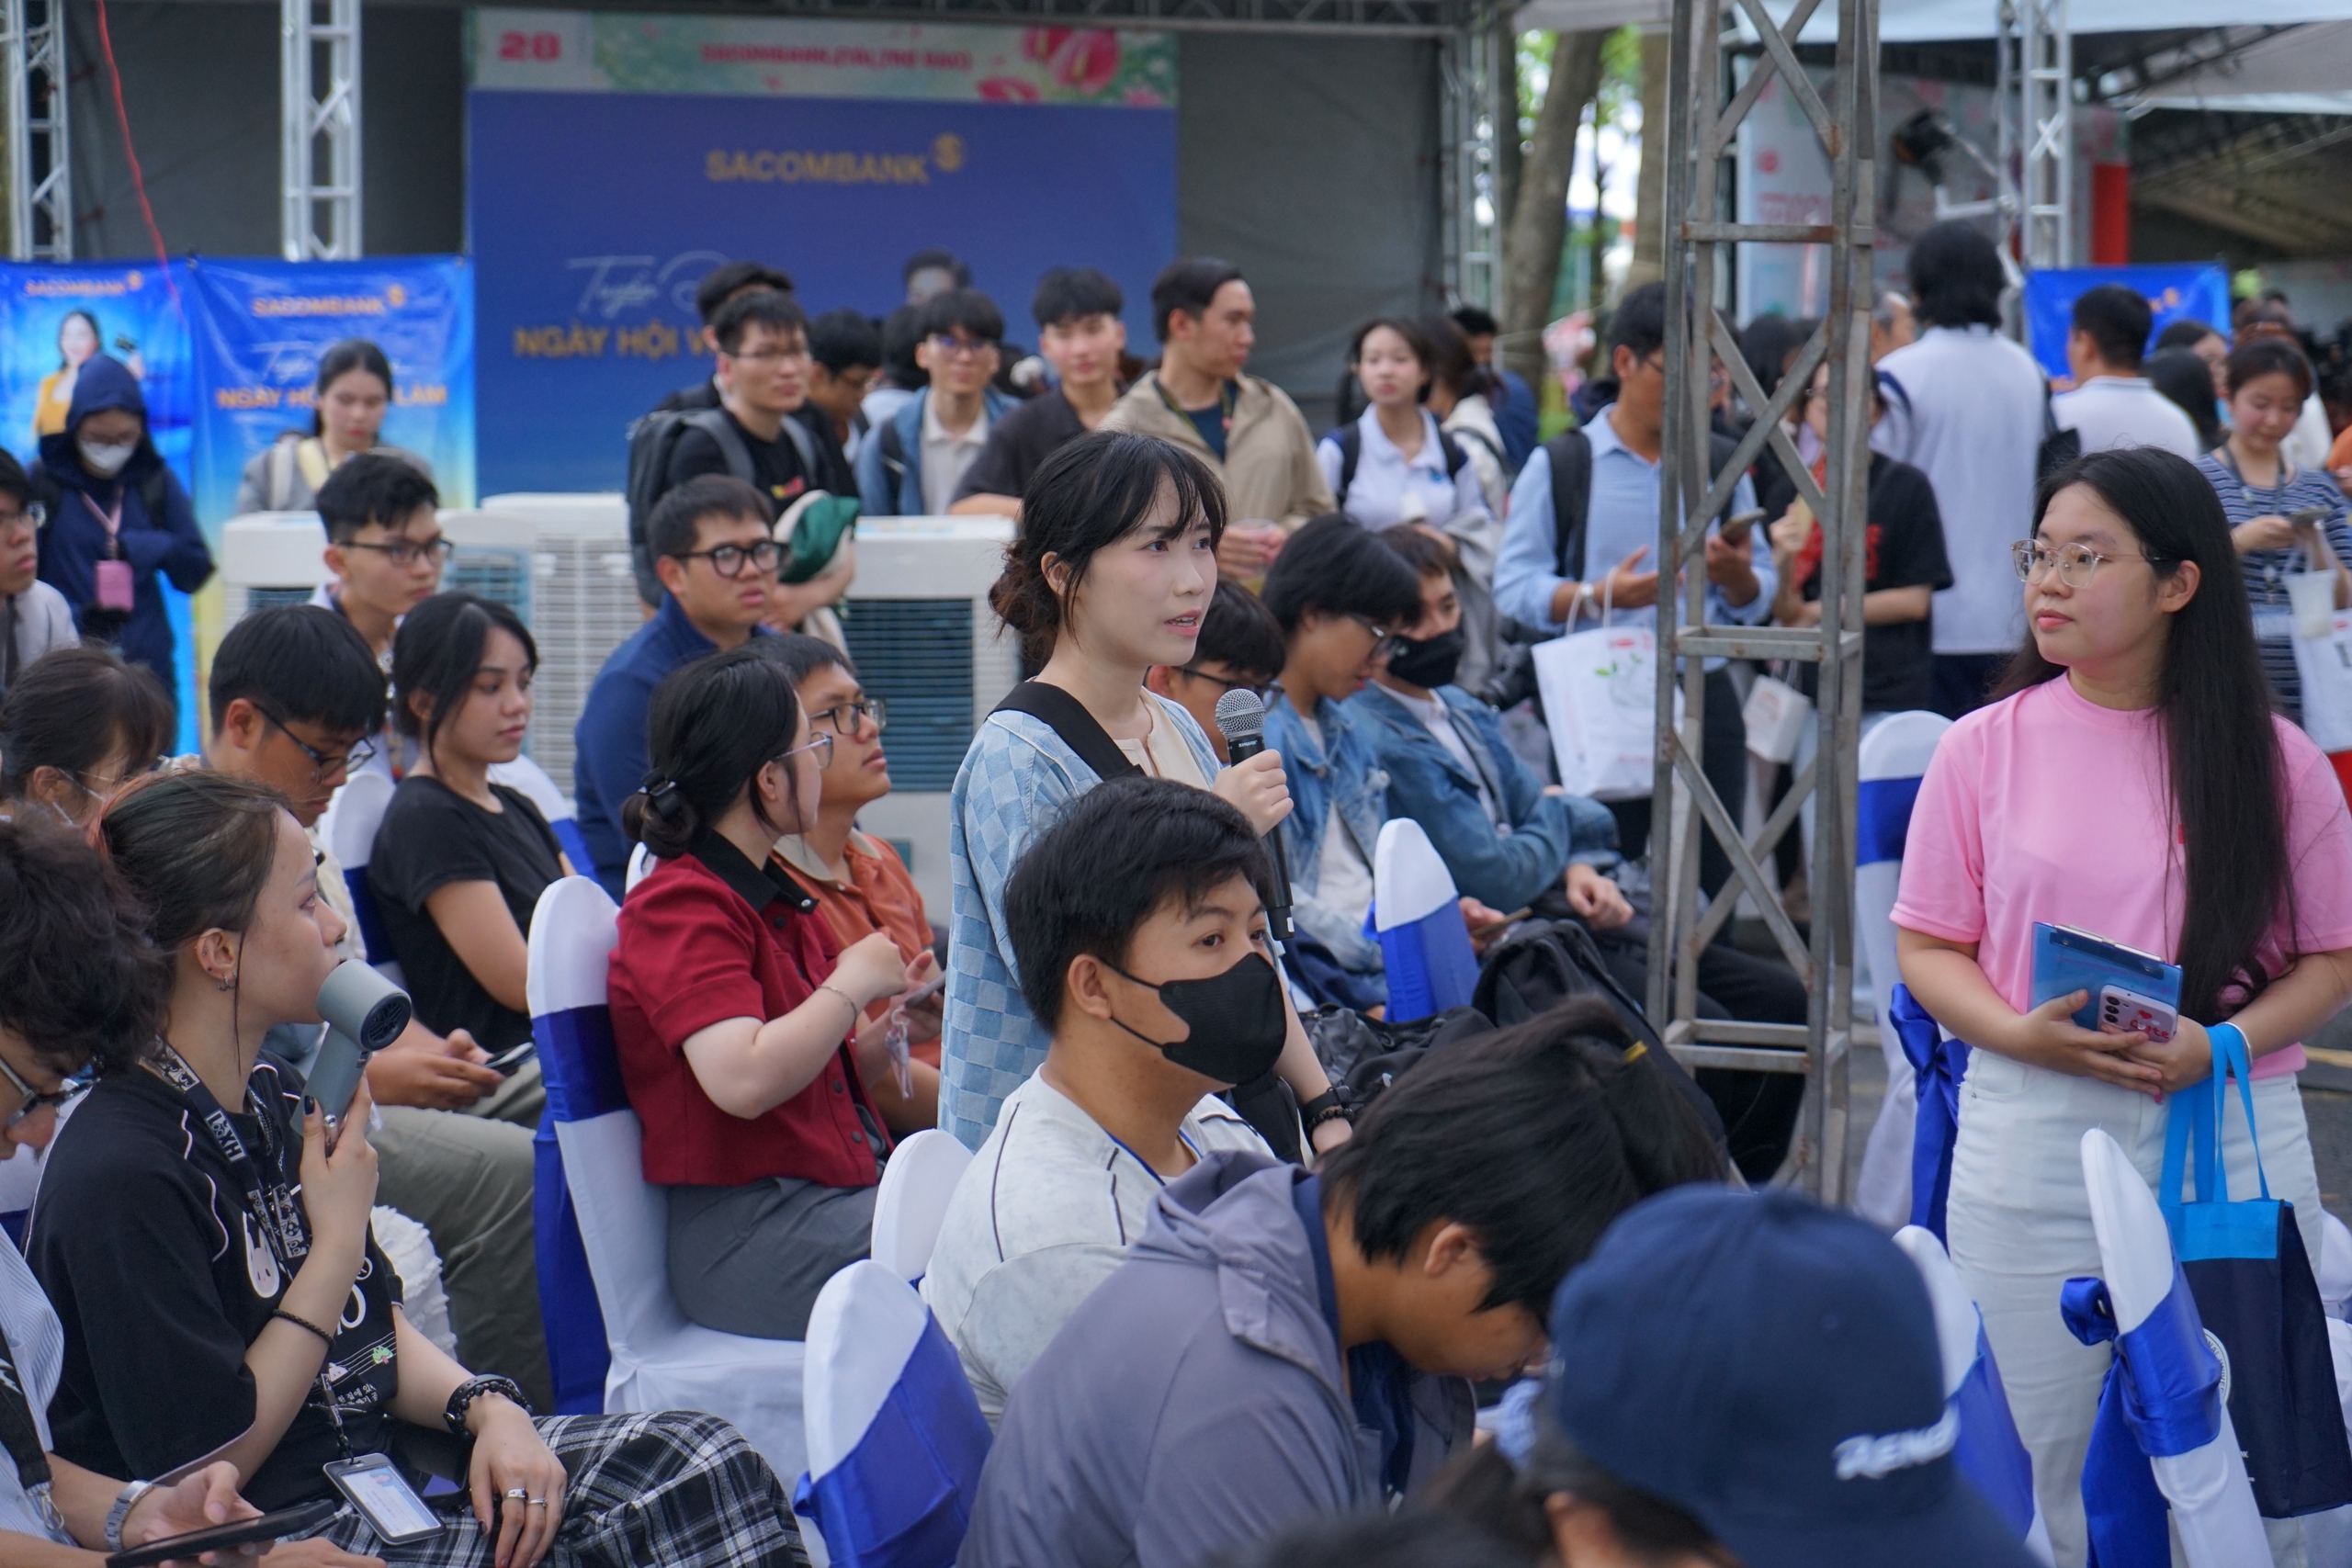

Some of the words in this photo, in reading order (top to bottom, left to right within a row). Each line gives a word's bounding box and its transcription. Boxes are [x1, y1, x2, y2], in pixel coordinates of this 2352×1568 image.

[706, 149, 930, 185] SACOMBANK
[253, 296, 386, 317] SACOMBANK
[514, 321, 609, 358] NGÀY
[616, 320, 678, 361] HỘI
